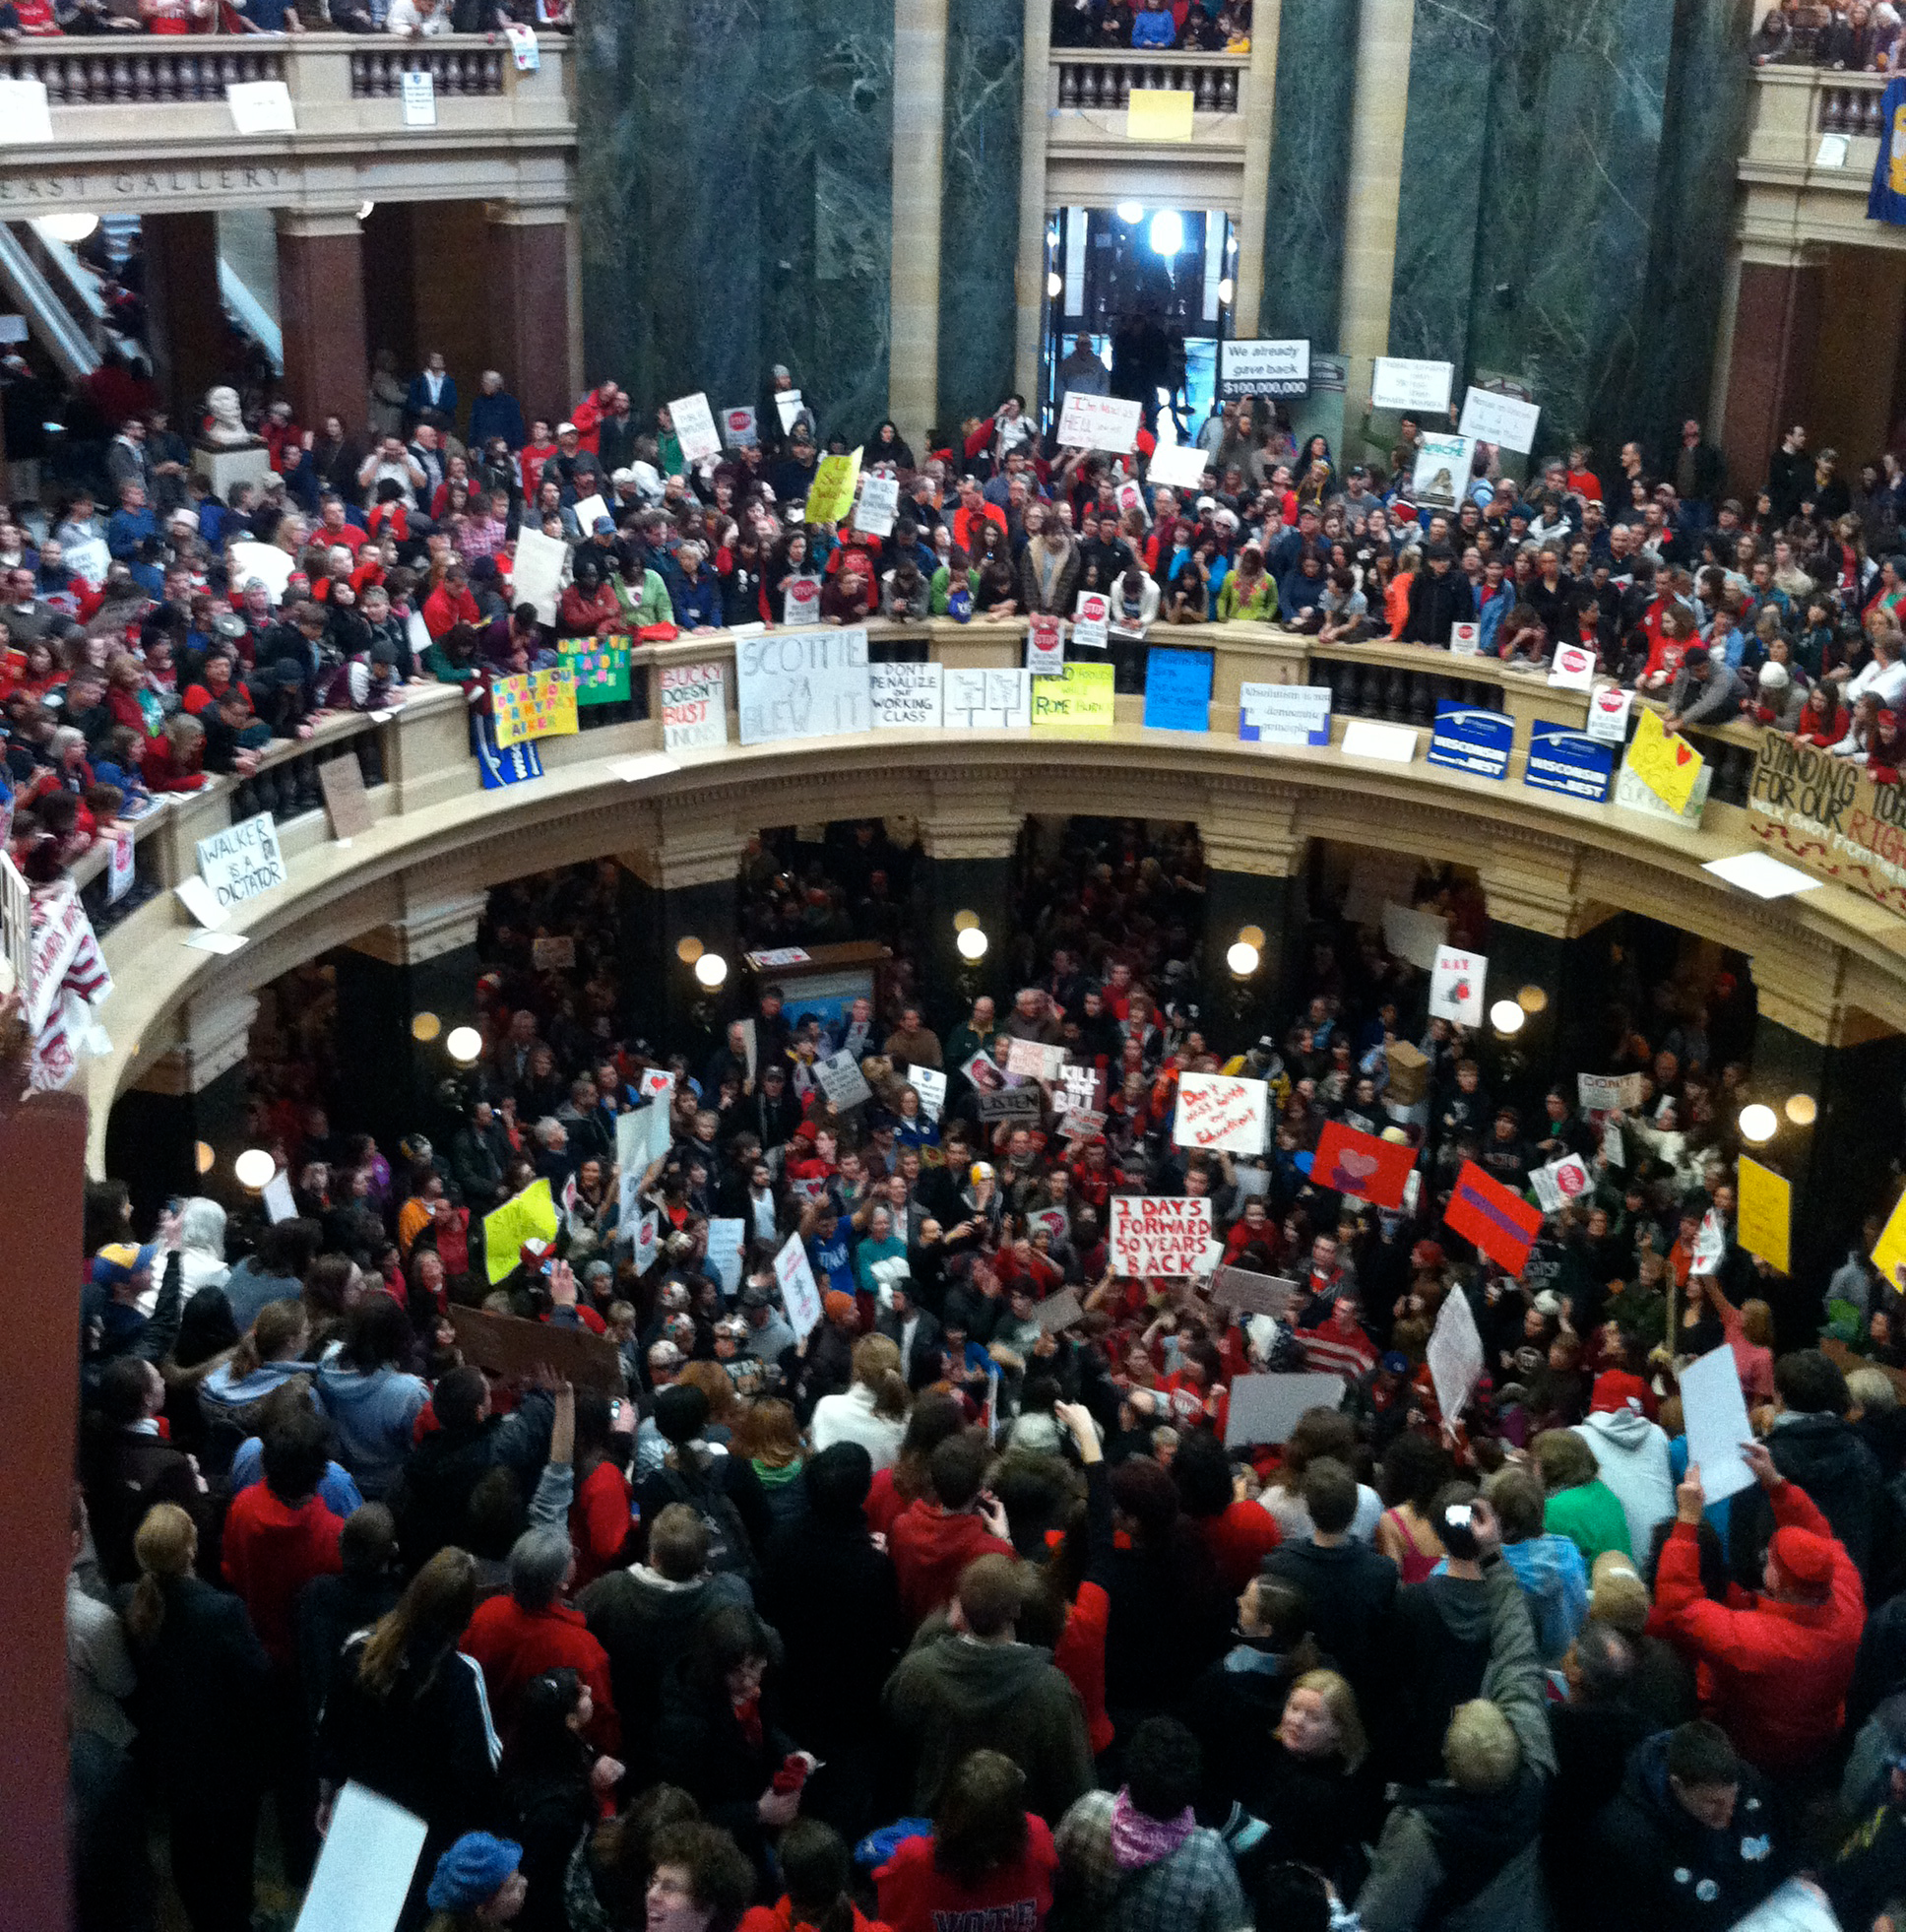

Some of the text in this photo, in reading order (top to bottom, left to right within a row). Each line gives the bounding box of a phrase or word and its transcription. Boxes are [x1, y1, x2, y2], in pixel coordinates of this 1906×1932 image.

[114, 167, 282, 193] GALLERY
[1228, 345, 1299, 359] We already
[1266, 363, 1298, 375] back
[1224, 381, 1307, 395] $100,000,000
[1083, 601, 1106, 615] STOP
[742, 630, 869, 677] SCOTTIE
[661, 664, 724, 689] BUCKY
[869, 676, 937, 689] PENALIZE
[663, 700, 709, 727] BUST
[834, 690, 862, 730] IT
[871, 698, 933, 710] WORKING
[1036, 696, 1071, 716] ROME
[882, 710, 926, 723] CLASS
[1433, 735, 1507, 762] WISCONSIN
[1530, 756, 1607, 785] WISCONSIN
[1753, 766, 1795, 809] FOR
[1800, 786, 1843, 834] OUR
[200, 818, 270, 864] WALKER
[244, 855, 256, 871] A
[217, 861, 283, 907] DICTATOR
[1060, 1064, 1101, 1085] KILL
[1052, 1090, 1094, 1113] BILL
[1142, 1198, 1202, 1216] DAYS
[1118, 1218, 1211, 1236] FORWARD
[1143, 1237, 1207, 1254] YEARS
[1126, 1255, 1196, 1274] BACK
